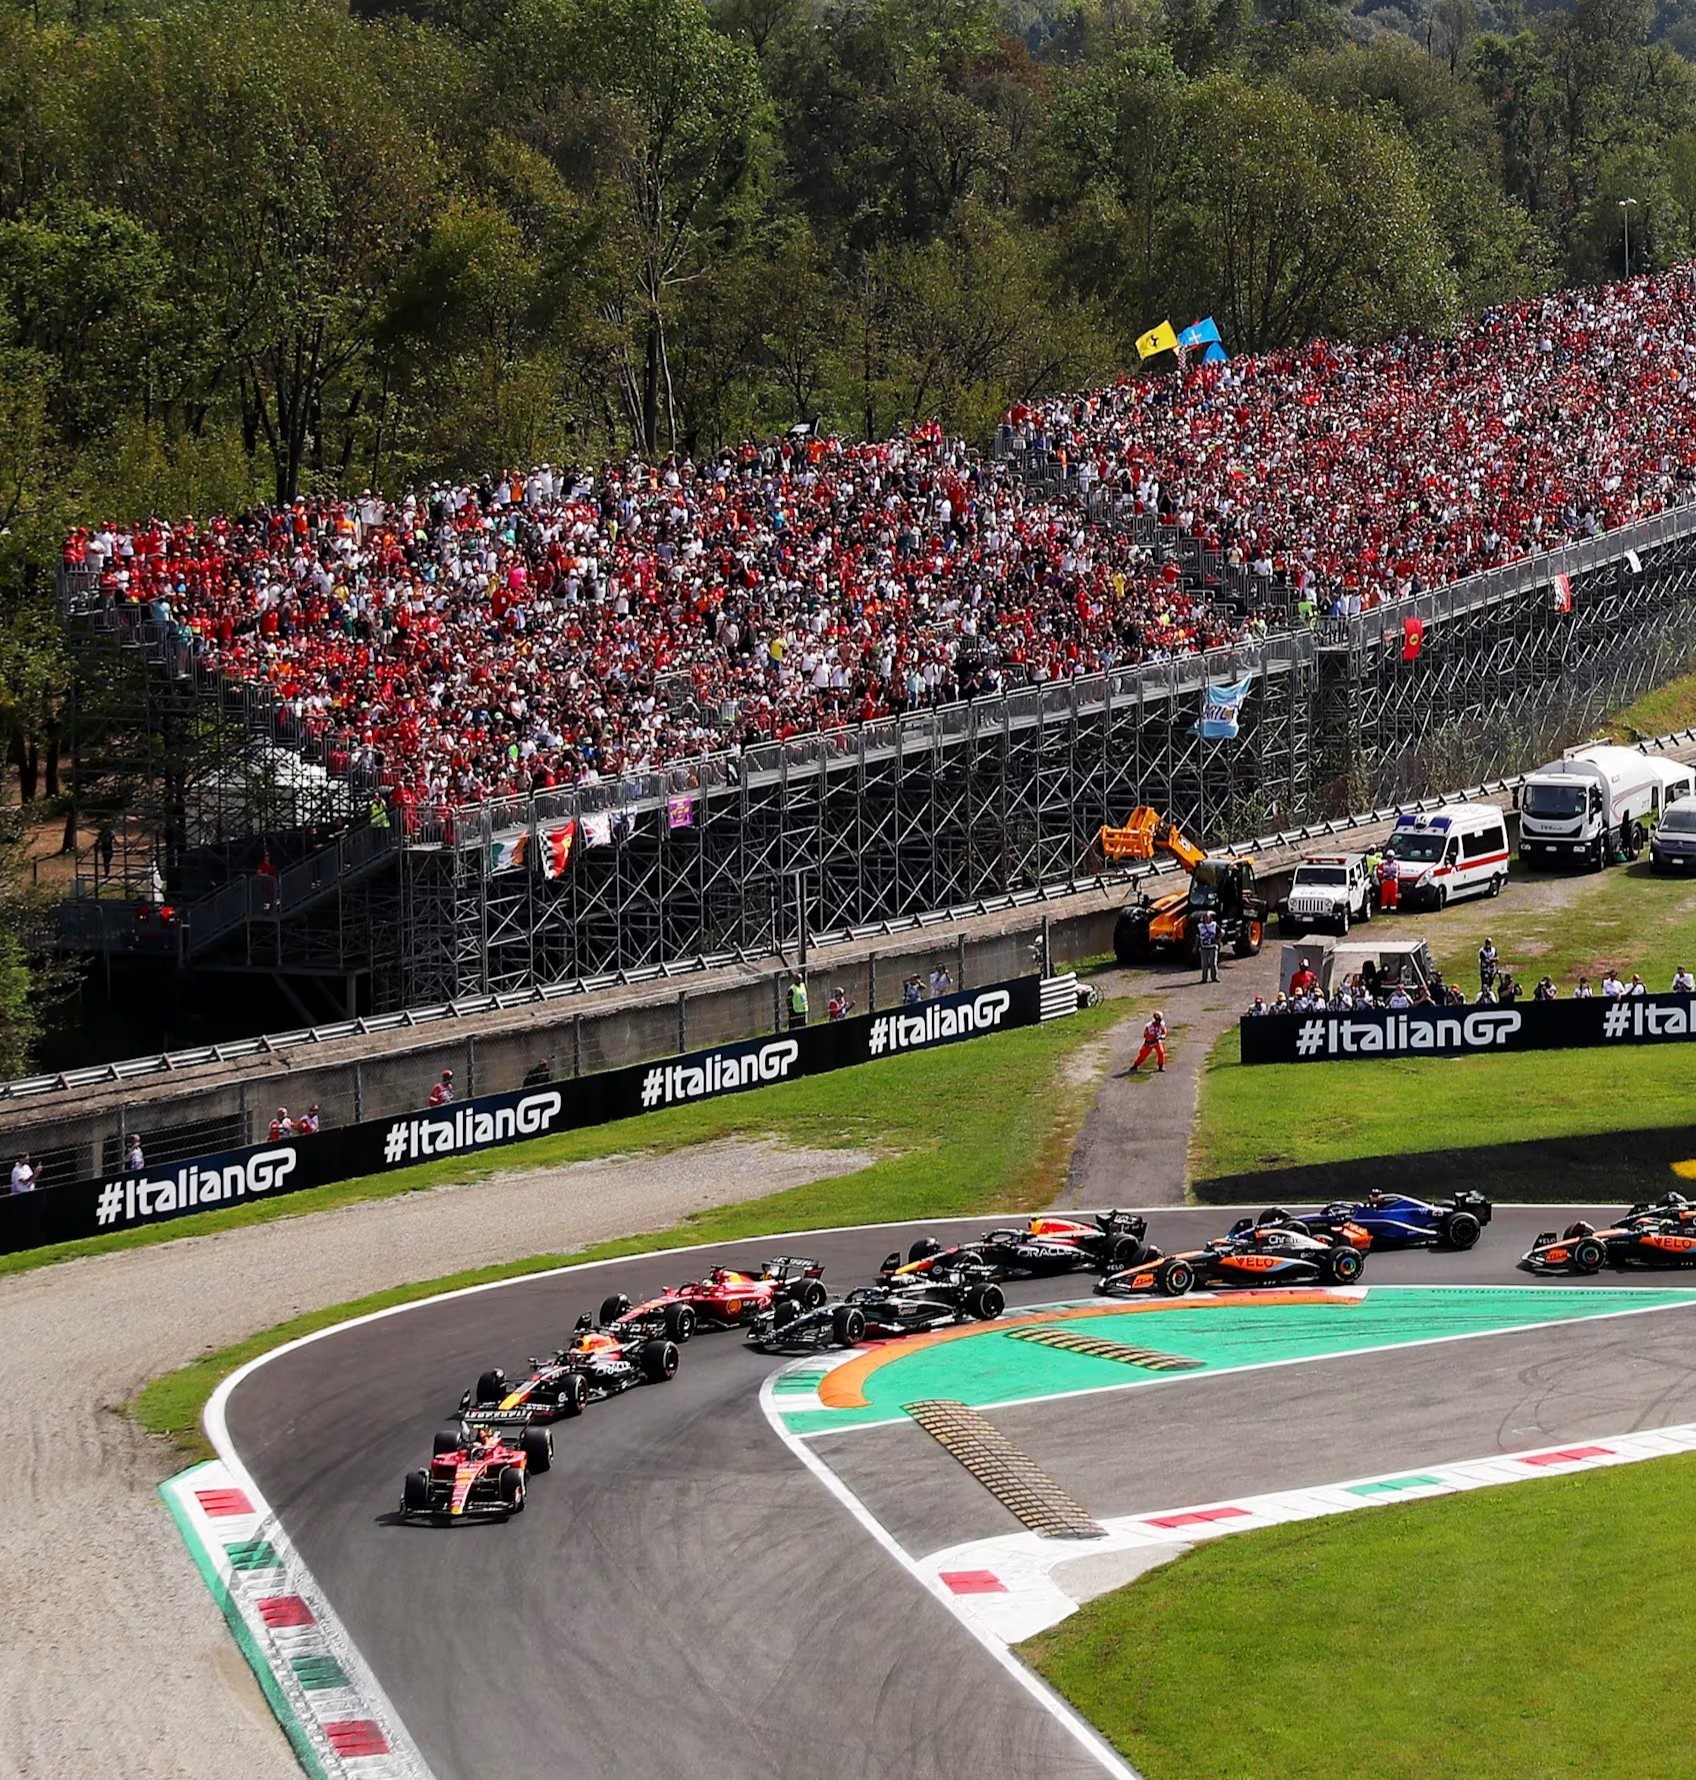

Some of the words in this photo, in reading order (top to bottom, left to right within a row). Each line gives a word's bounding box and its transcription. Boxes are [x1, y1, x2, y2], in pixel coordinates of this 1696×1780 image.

[868, 989, 1010, 1055] #ItalianGP
[1296, 1010, 1521, 1055] #ItalianGP
[641, 1039, 799, 1106] #ItalianGP
[383, 1091, 562, 1163] #ItalianGP
[96, 1147, 297, 1225] #ItalianGP
[1017, 1246, 1073, 1258] ORACLE
[1235, 1257, 1275, 1268] VELO
[1653, 1236, 1692, 1249] VELO
[1106, 1263, 1125, 1271] VELO
